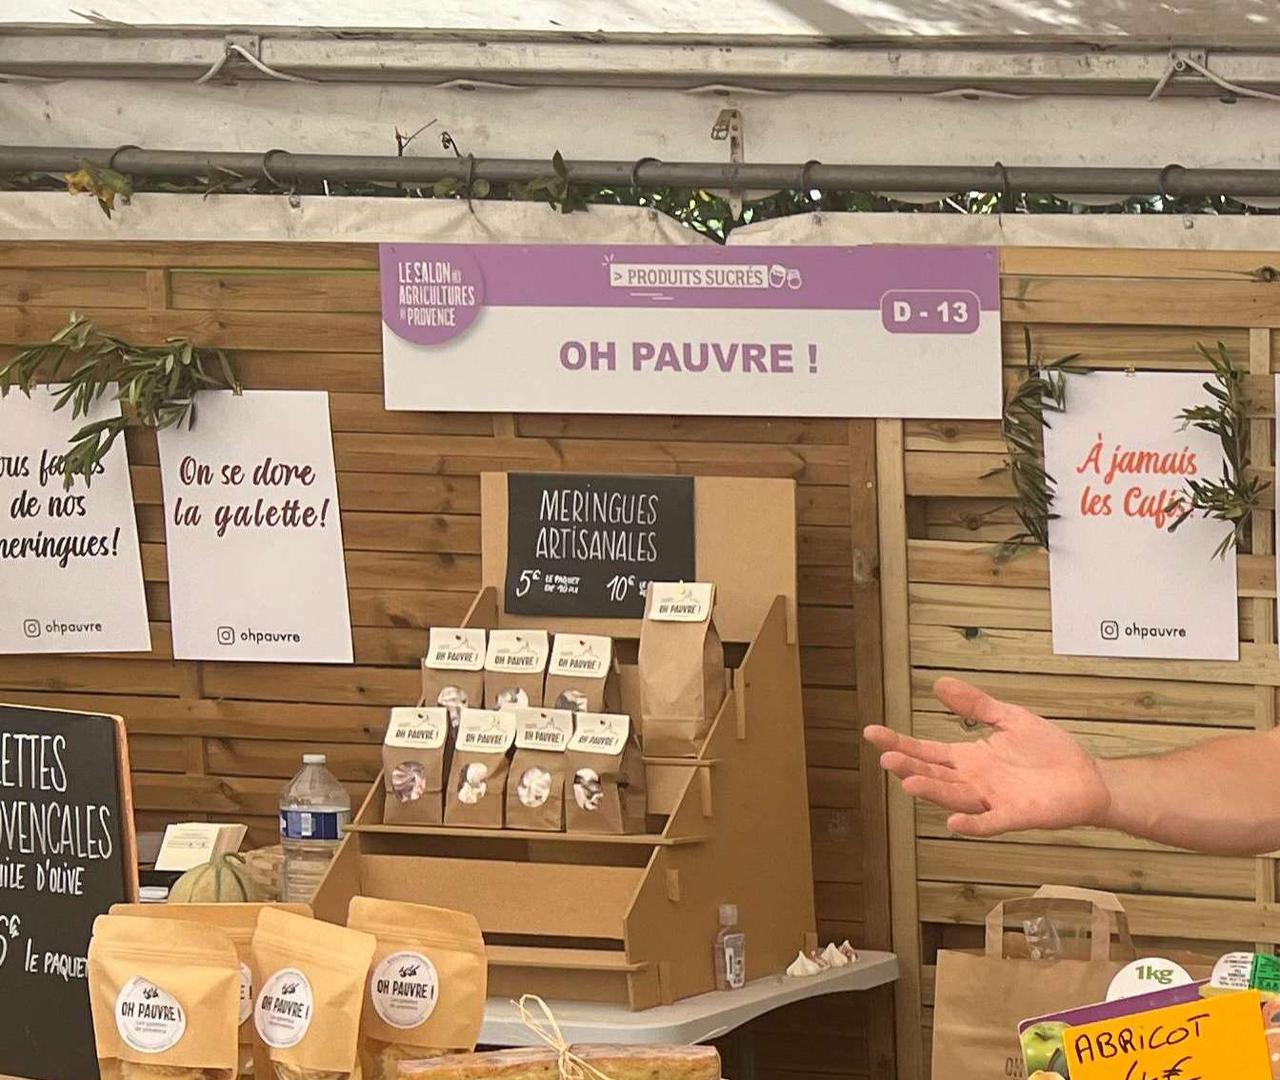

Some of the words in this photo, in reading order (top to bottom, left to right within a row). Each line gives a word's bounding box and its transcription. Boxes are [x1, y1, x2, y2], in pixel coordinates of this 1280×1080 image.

[398, 261, 412, 283] LE
[413, 261, 451, 284] SALON
[628, 268, 701, 286] PRODUITS
[705, 264, 764, 287] SUCRÉS
[399, 285, 475, 306] AGRICULTURES
[407, 307, 457, 327] PROVENCE
[893, 302, 912, 322] D
[937, 302, 969, 323] 13
[559, 341, 616, 372] OH
[631, 341, 794, 374] PAUVRE
[809, 343, 818, 374] !
[1076, 432, 1103, 473] À
[1104, 445, 1198, 485] jamais
[180, 455, 214, 486] On
[221, 464, 245, 486] se
[252, 457, 316, 486] dore
[10, 489, 41, 518] de
[48, 493, 87, 518] nos
[1081, 485, 1112, 516] les
[174, 497, 202, 526] la
[214, 497, 330, 538] galette!
[46, 620, 102, 636] ohpauvre
[240, 628, 301, 645] ohpauvre
[1125, 622, 1187, 640] ohpauvre
[0, 733, 67, 792] ETTES
[0, 800, 113, 859] VENCALES
[1135, 964, 1174, 985] 1kg
[376, 979, 390, 994] OH
[392, 980, 428, 999] PAUVRE
[121, 1001, 135, 1017] OH
[138, 1002, 176, 1021] PAUVRE
[261, 995, 273, 1011] OH
[273, 997, 304, 1018] PAUVRE
